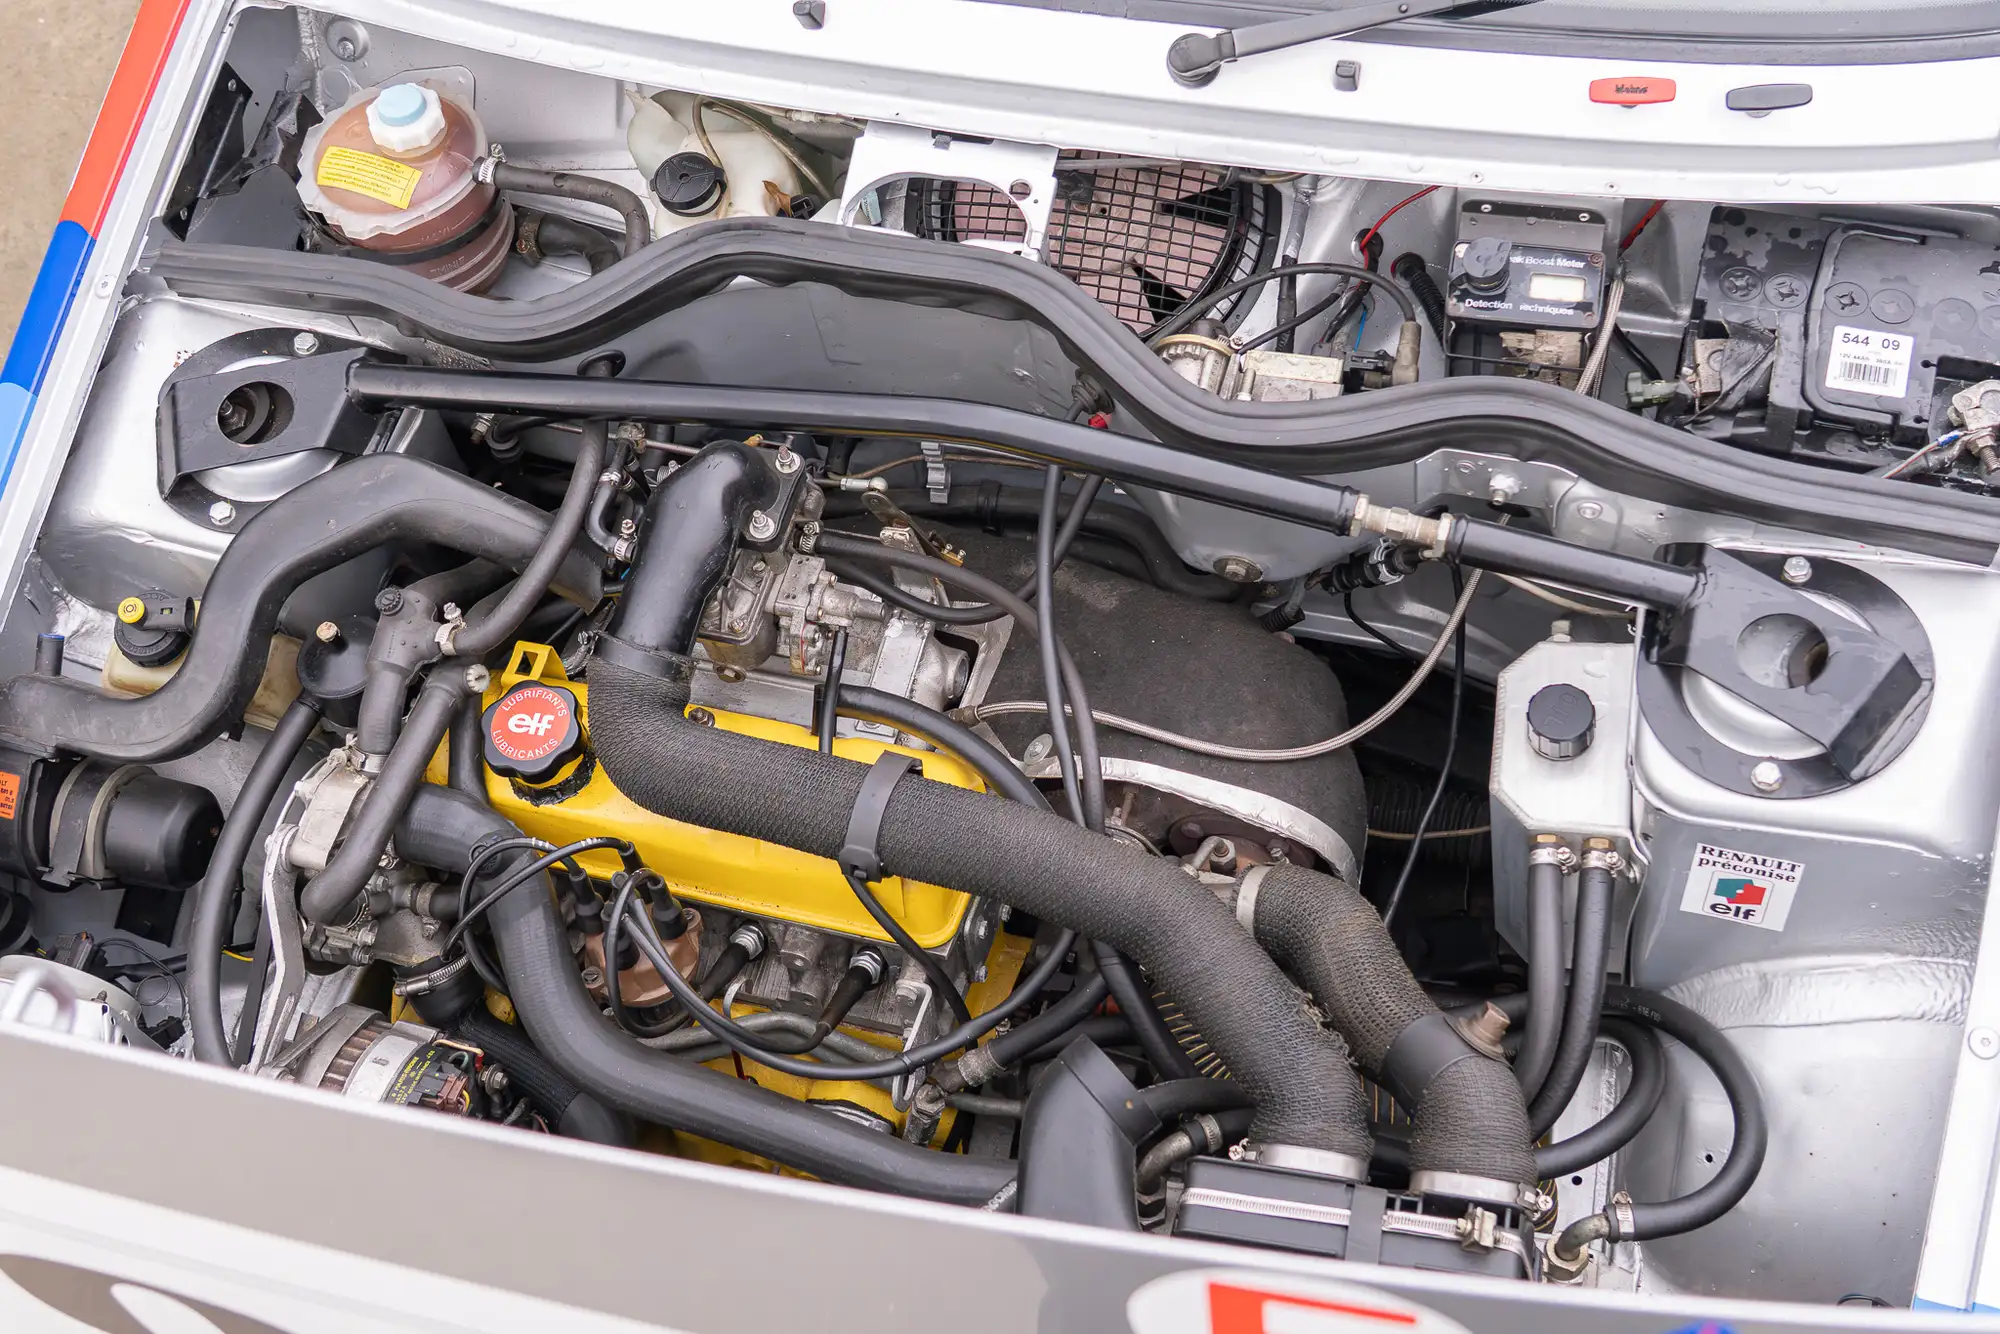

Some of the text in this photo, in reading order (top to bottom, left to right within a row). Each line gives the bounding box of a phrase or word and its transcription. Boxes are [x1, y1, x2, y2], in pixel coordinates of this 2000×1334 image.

[1525, 256, 1554, 266] Boost
[1556, 258, 1586, 269] Meter
[1464, 299, 1513, 310] Detection
[1842, 333, 1901, 351] 544 09
[501, 690, 567, 717] LUBRIFIANTS
[507, 712, 555, 736] elf
[493, 729, 559, 759] LUBRICANTS
[1697, 857, 1796, 883] préconise
[1700, 845, 1801, 872] RENAULT
[1710, 903, 1756, 920] elf
